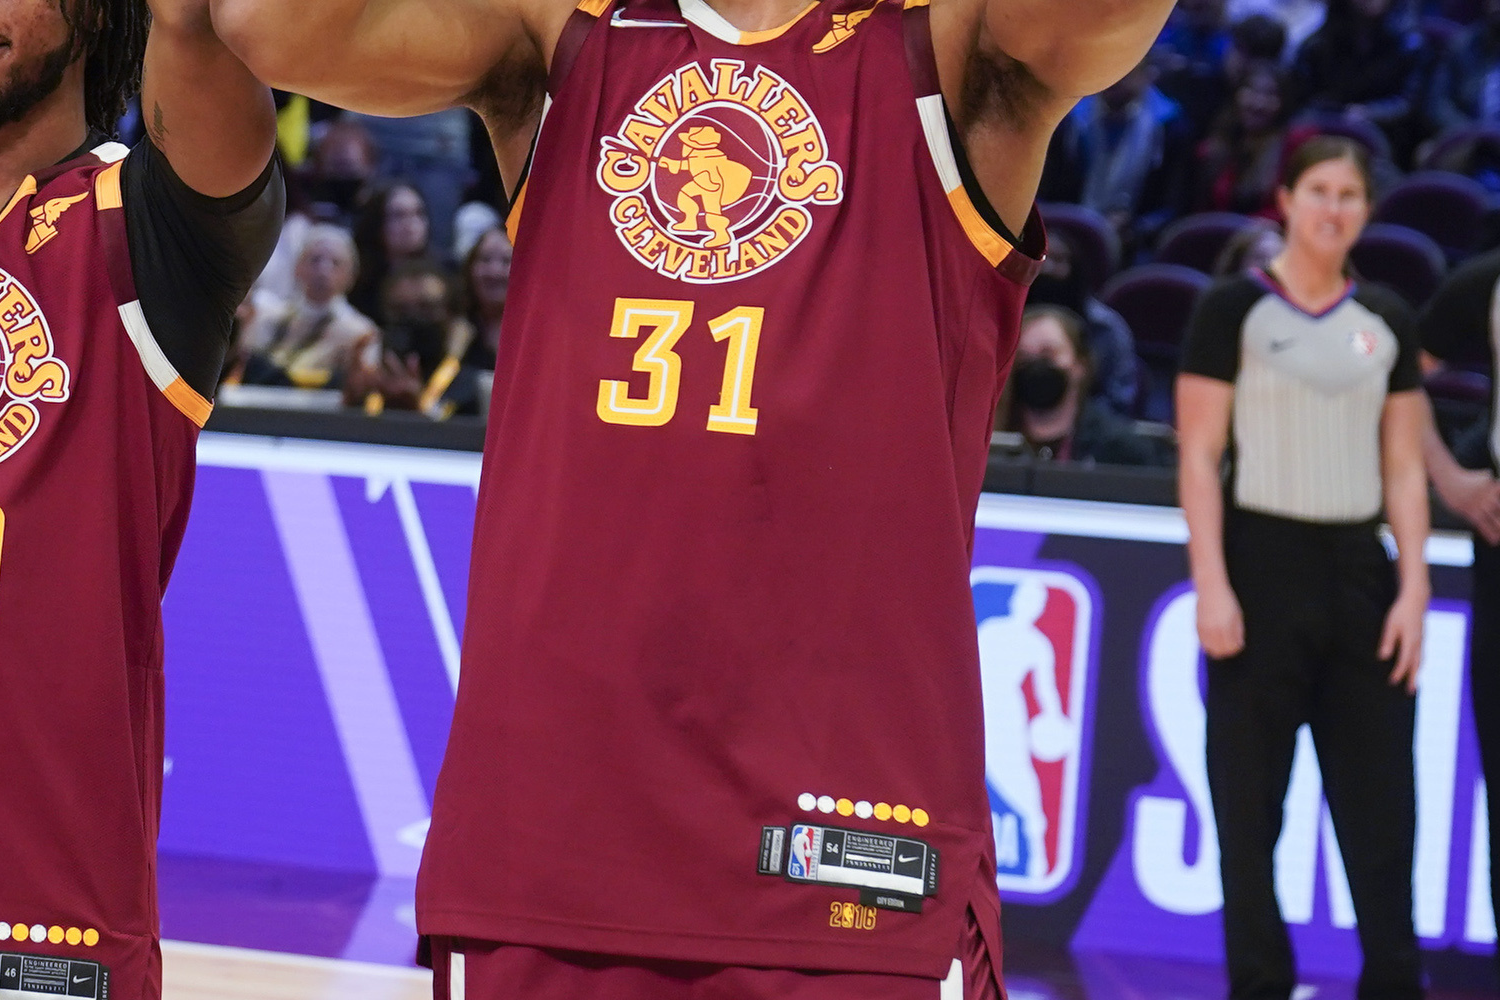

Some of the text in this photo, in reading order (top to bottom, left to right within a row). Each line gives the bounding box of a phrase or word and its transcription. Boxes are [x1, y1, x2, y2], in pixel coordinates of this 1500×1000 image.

[597, 59, 843, 206] CAVALIERS
[611, 194, 813, 284] CLEVELAND
[596, 297, 766, 436] 31
[825, 842, 839, 854] 54
[847, 835, 894, 847] ENGINEERED
[829, 901, 877, 930] 2016
[5, 968, 17, 978] 46
[24, 959, 68, 969] ENGINEERED
